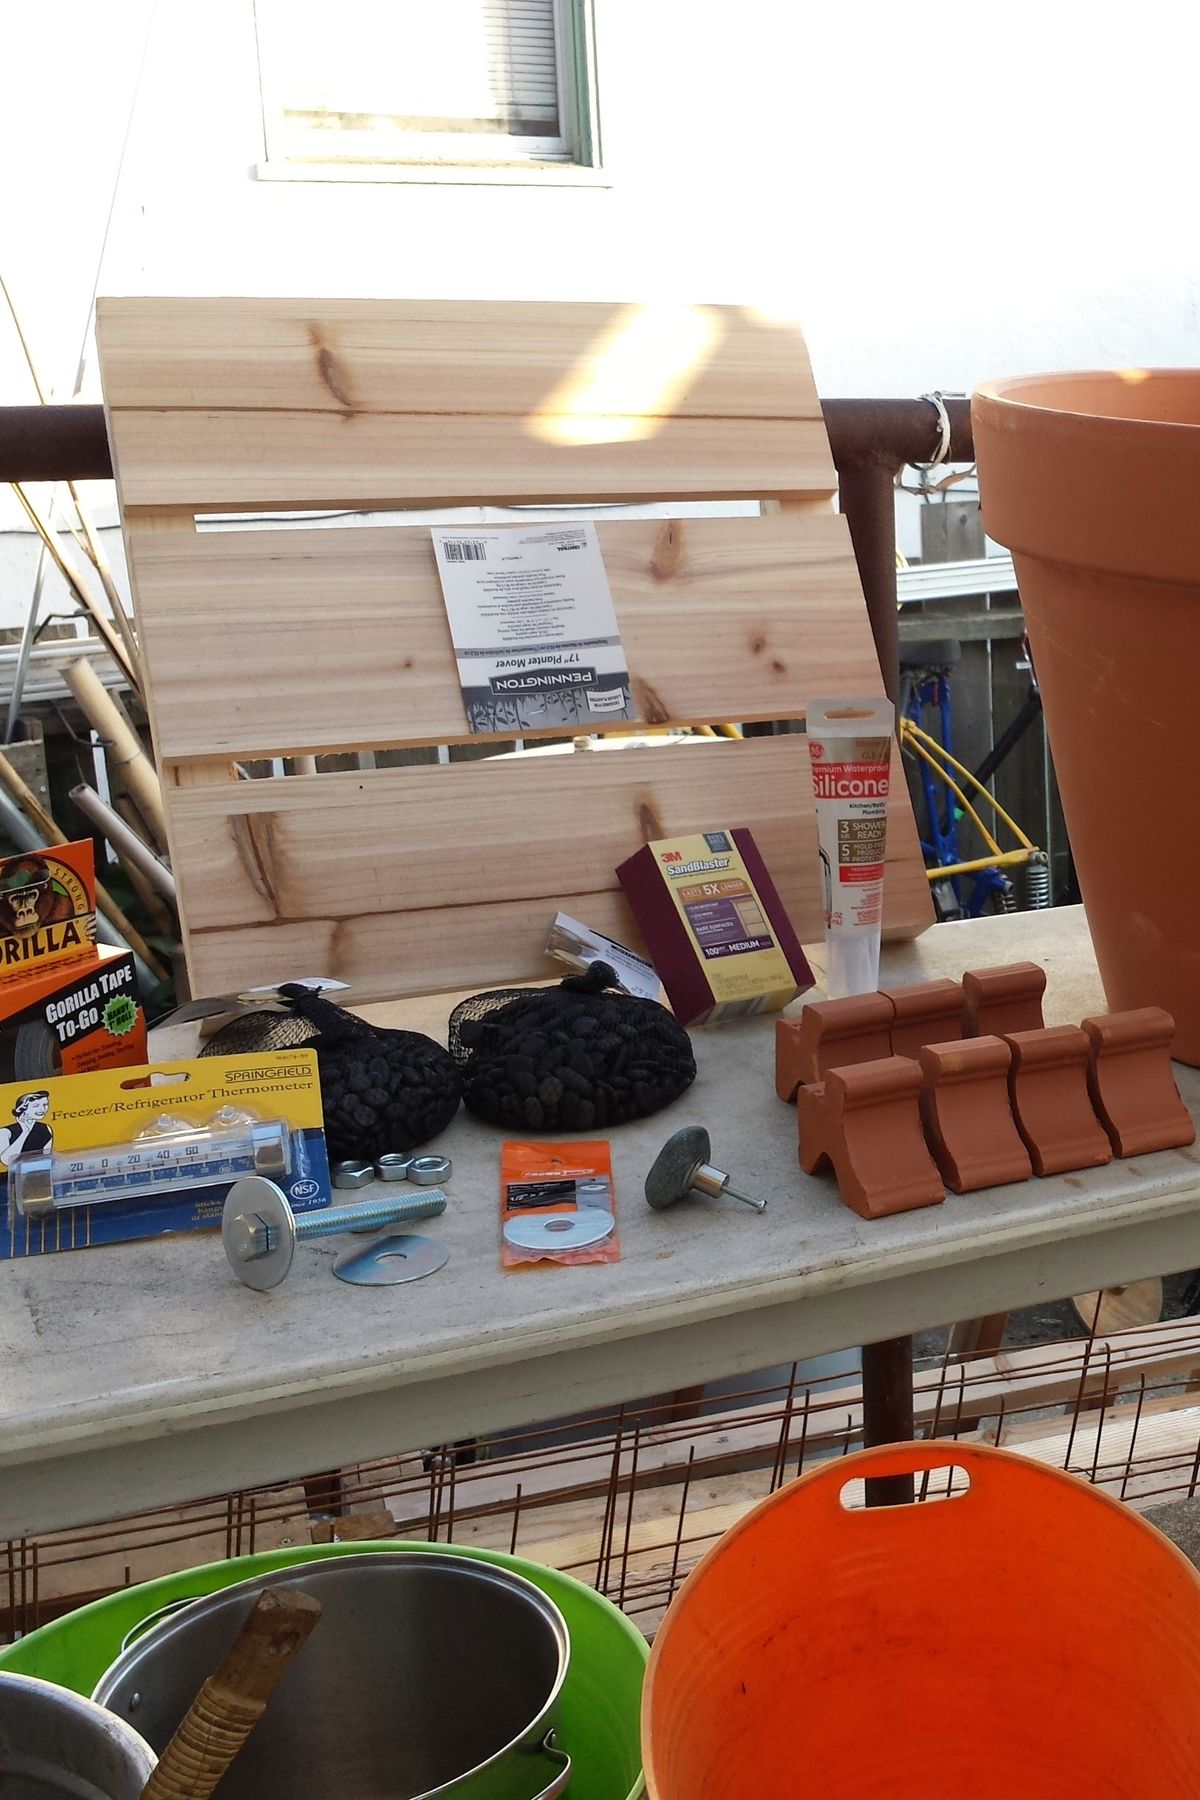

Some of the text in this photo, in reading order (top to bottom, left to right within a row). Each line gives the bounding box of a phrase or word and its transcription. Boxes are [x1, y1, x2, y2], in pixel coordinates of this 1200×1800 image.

[496, 659, 526, 668] Mover
[527, 655, 562, 665] Planter
[496, 672, 592, 690] PENNINGTON
[843, 763, 889, 773] Waterproof
[813, 774, 889, 797] Silicone
[841, 821, 849, 834] 3
[857, 830, 882, 840] READY
[661, 851, 683, 863] 3M
[841, 844, 850, 857] 5
[667, 858, 731, 876] SandBlaster
[53, 867, 85, 911] STRONG
[703, 883, 720, 896] 5X
[0, 920, 81, 965] RILLA
[705, 947, 719, 957] 100
[729, 940, 761, 952] MEDIUM
[46, 983, 100, 1024] GORILLA
[99, 965, 132, 994] TAPE
[56, 1007, 99, 1042] TO-GO
[225, 1066, 312, 1082] SPRINGFIELD
[51, 1081, 313, 1121] Freezer/Refrigerator Thermometer
[127, 1154, 141, 1164] 20
[157, 1150, 170, 1159] 40
[294, 1183, 315, 1197] NSF
